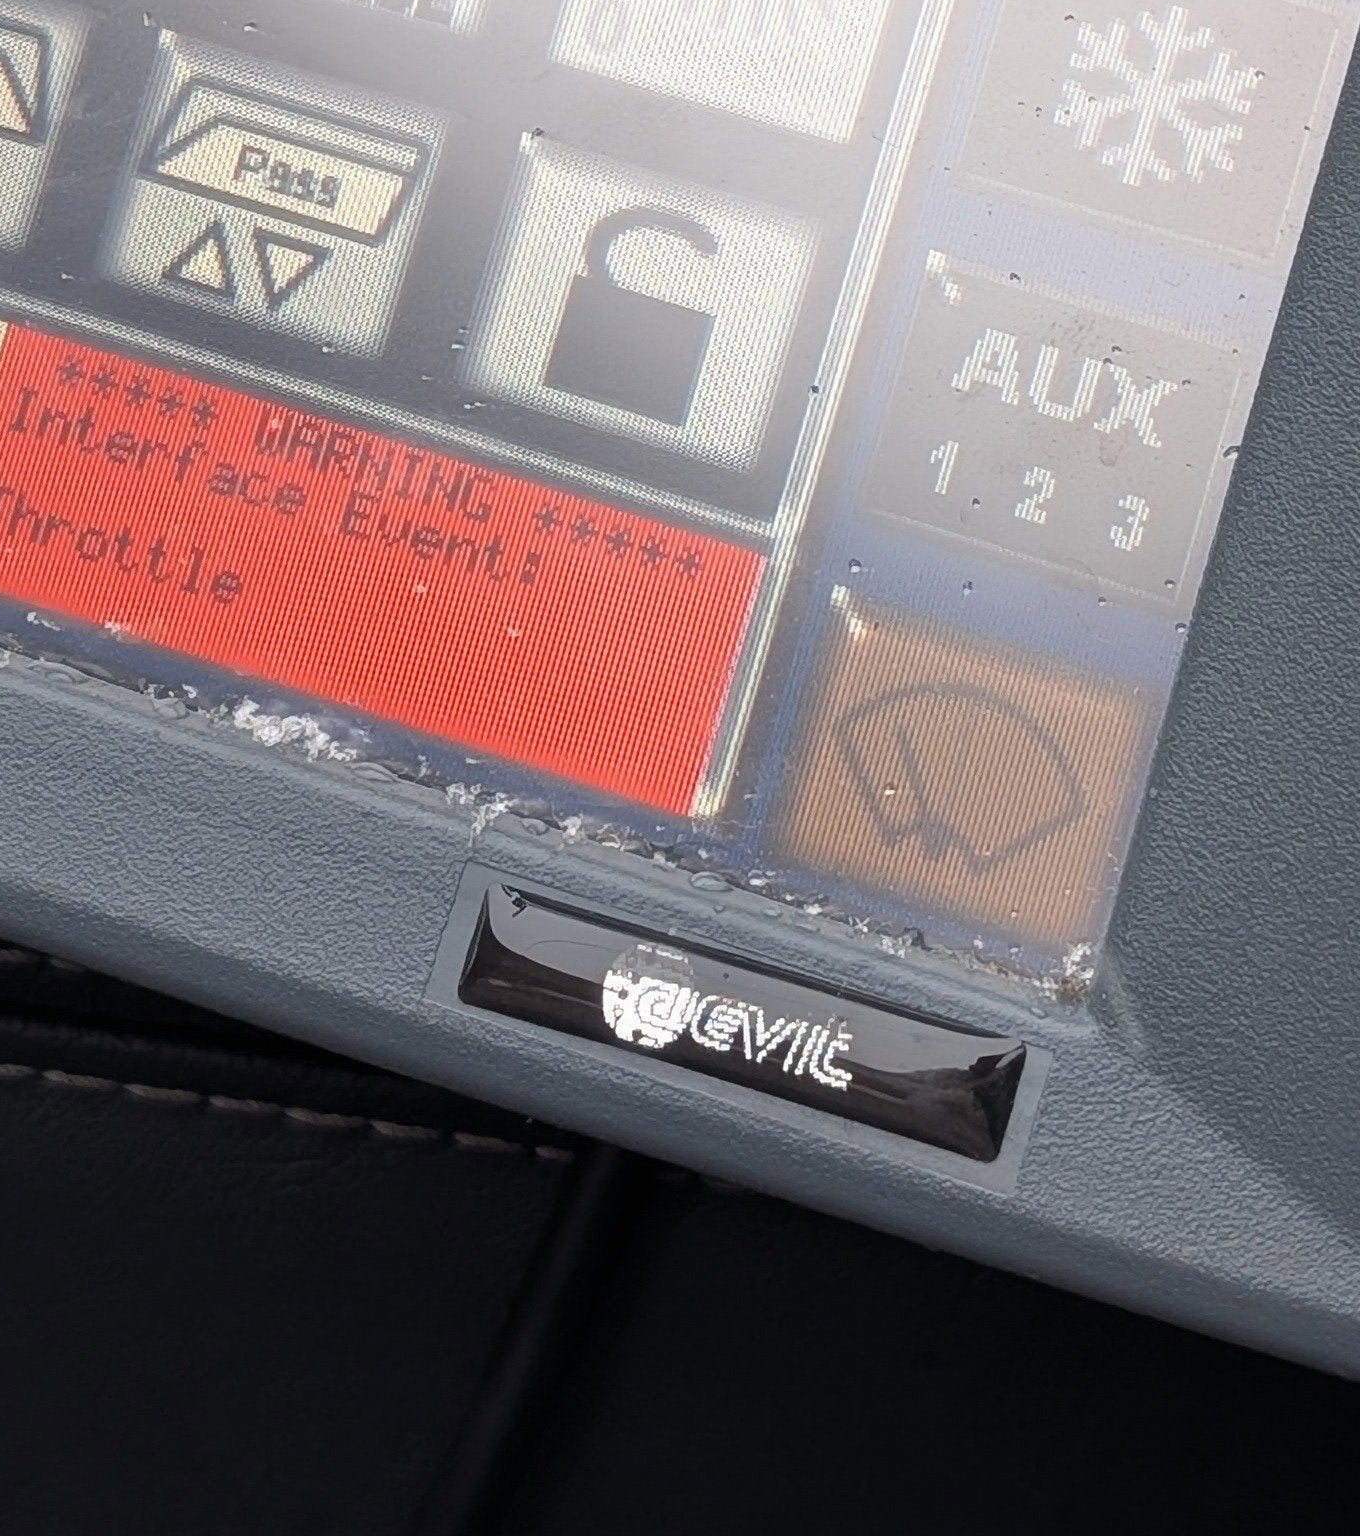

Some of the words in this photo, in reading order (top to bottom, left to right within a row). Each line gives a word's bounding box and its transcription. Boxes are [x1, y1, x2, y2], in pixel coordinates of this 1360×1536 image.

[234, 145, 339, 208] Pass
[951, 327, 1178, 449] AUX
[9, 385, 307, 519] Interface
[343, 489, 540, 586] Event:
[253, 401, 497, 524] WARNING
[931, 440, 960, 495] 1
[1014, 467, 1056, 524] 2
[1109, 494, 1150, 552] 3
